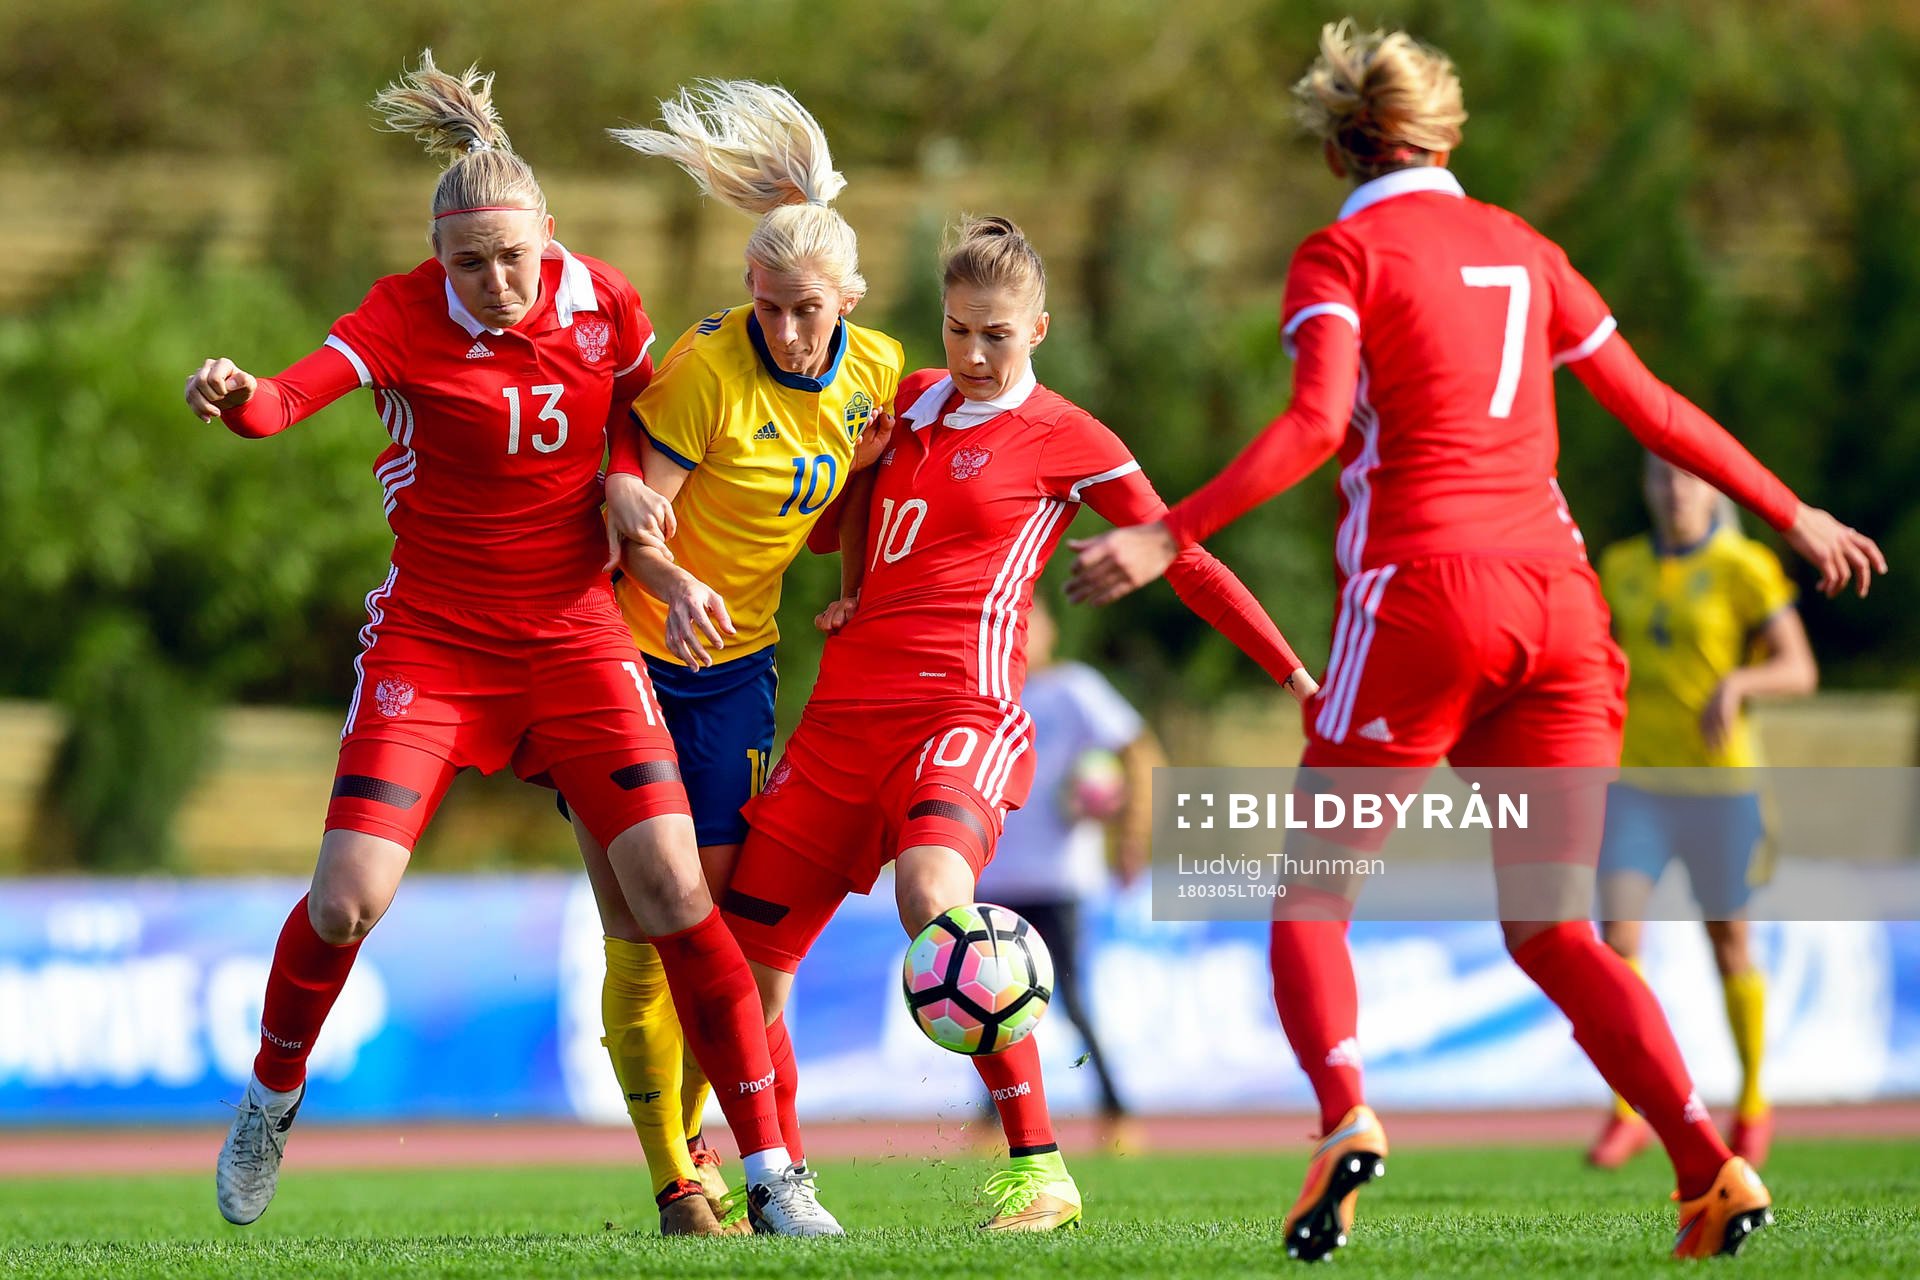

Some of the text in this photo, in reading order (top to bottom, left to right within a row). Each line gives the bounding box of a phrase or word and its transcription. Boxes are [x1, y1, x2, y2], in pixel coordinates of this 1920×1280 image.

[466, 351, 495, 359] adidas
[1460, 265, 1530, 418] 7
[502, 383, 568, 455] 13
[753, 432, 780, 440] adidas
[778, 454, 836, 516] 10
[870, 497, 928, 573] 10
[621, 661, 670, 734] 1
[915, 727, 978, 782] 10
[261, 1024, 303, 1048] ОССИЯ
[739, 1068, 776, 1094] РОССИ
